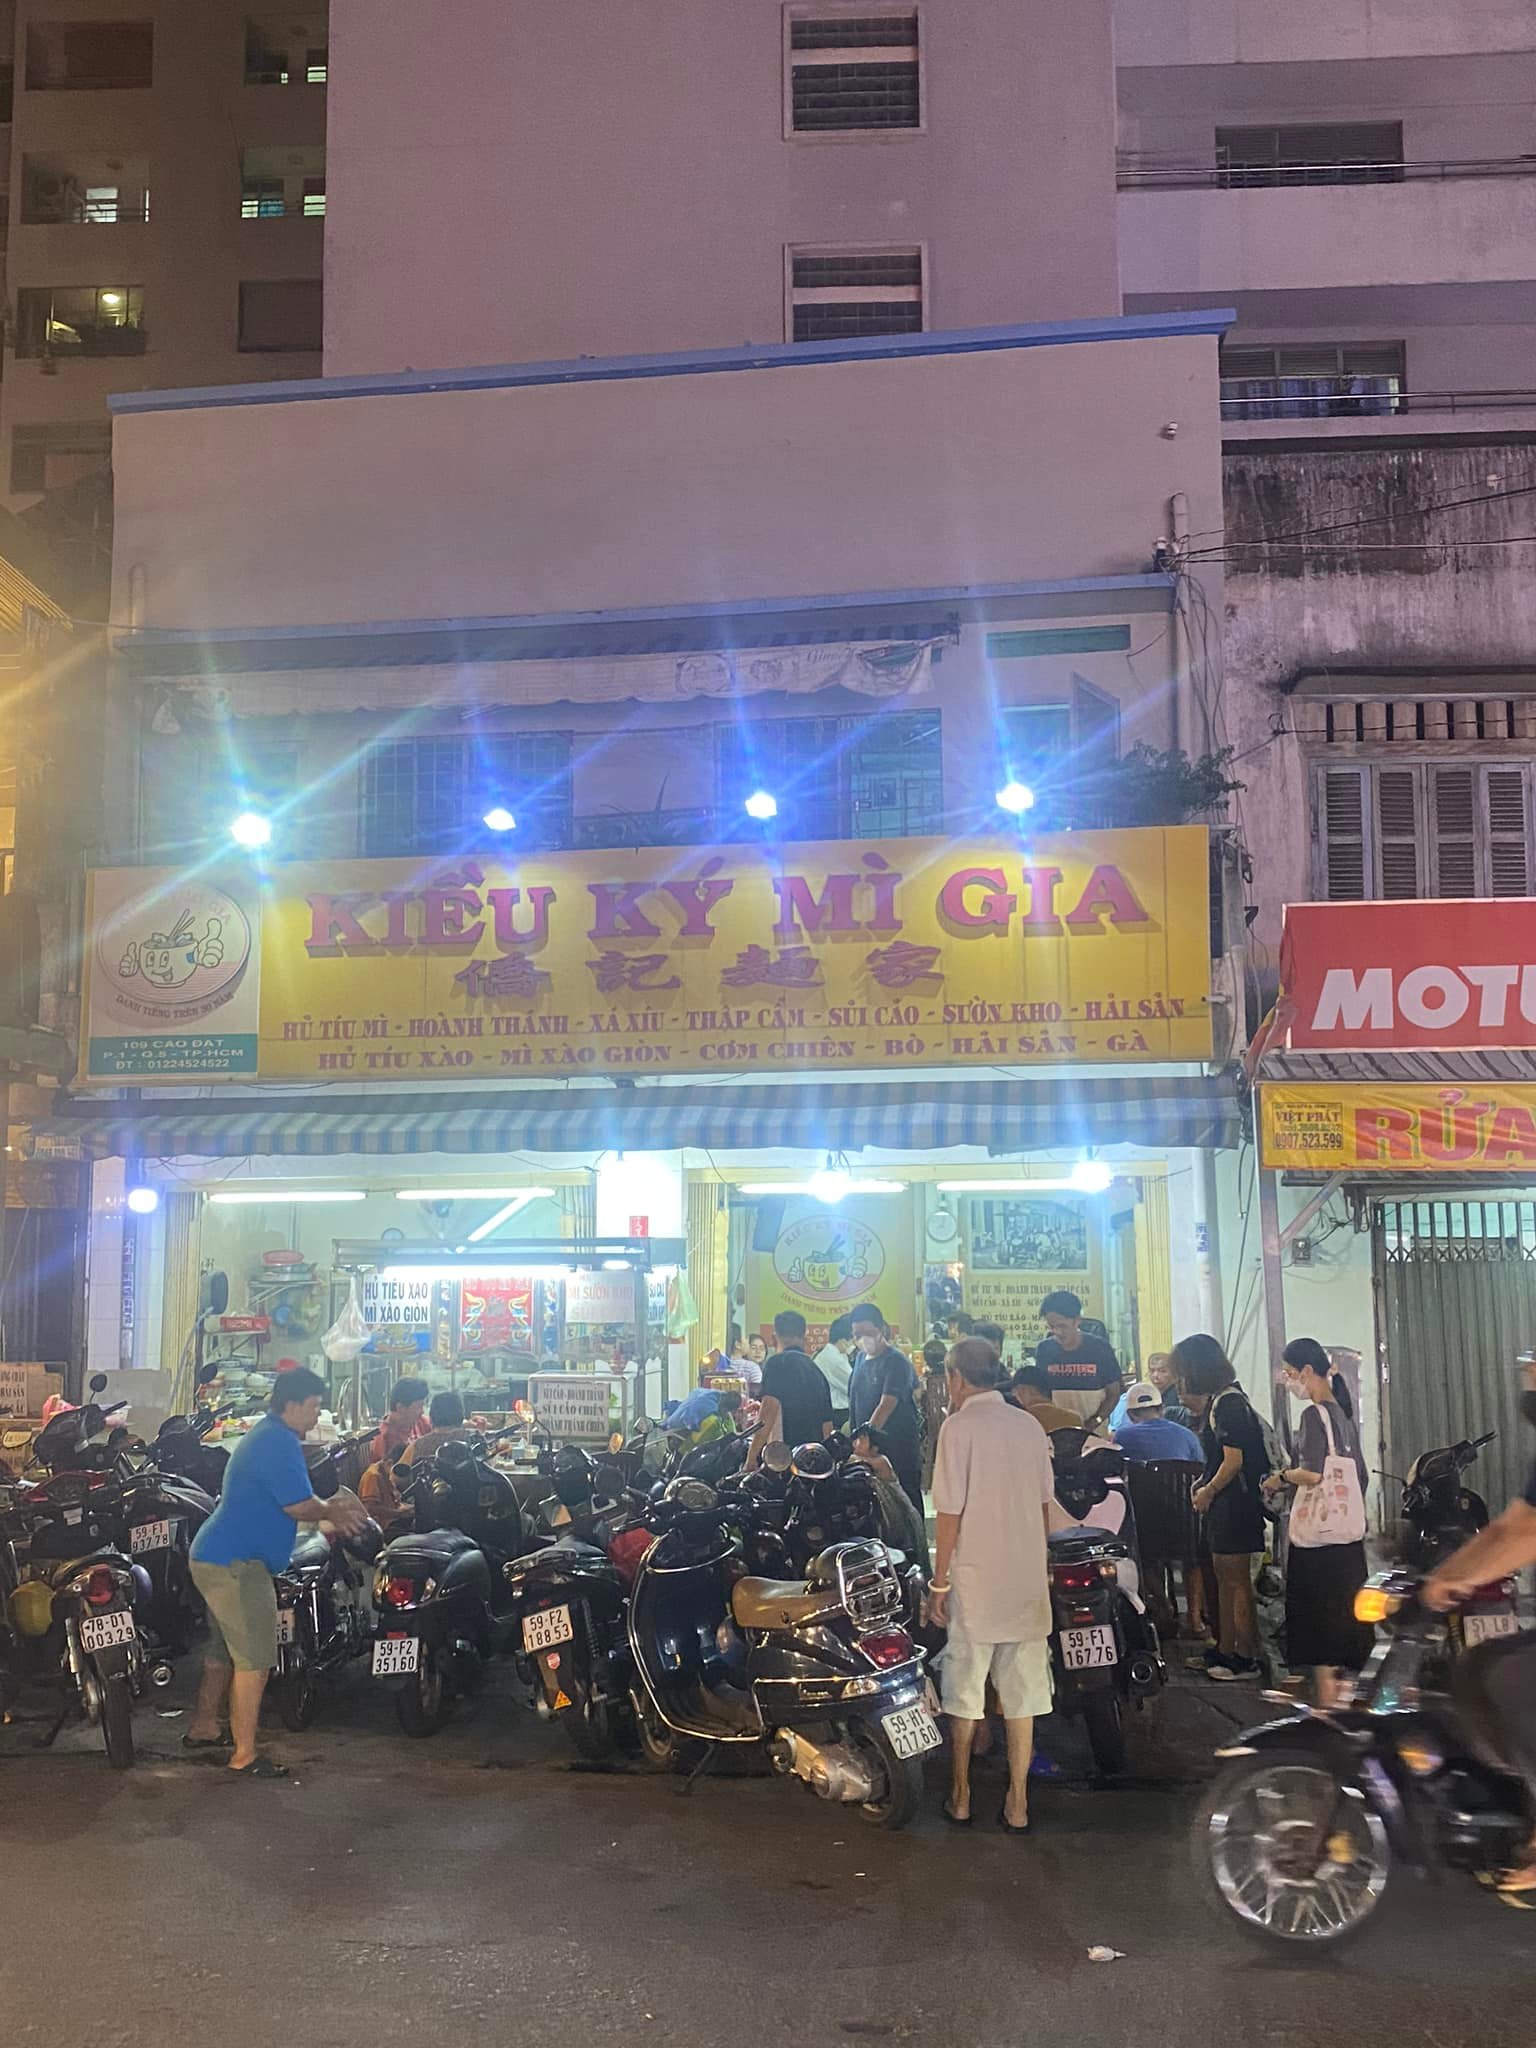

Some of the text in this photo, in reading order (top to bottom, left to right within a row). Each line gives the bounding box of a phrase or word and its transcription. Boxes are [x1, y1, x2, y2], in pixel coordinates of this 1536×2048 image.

[304, 852, 1150, 946] KIỀU KÝ MÌ GIA
[1311, 965, 1536, 1030] MOT
[283, 1014, 313, 1040] HỦ
[362, 1013, 389, 1038] MÌ
[408, 1011, 484, 1038] HOÀNH
[491, 1009, 569, 1035] THÁNH
[686, 1004, 750, 1031] THẬP
[828, 999, 869, 1027] SỦI
[1011, 1001, 1062, 1023] KHO
[1085, 992, 1130, 1020] HẢI
[1137, 992, 1185, 1019] SẢN
[152, 1039, 188, 1048] CAO
[318, 1045, 357, 1070] HỦ
[365, 1045, 412, 1069] TÍU
[417, 1045, 474, 1068] XÀO
[501, 1042, 533, 1065] MÌ
[540, 1042, 597, 1065] XÀO
[603, 1039, 672, 1063] GIÒN
[700, 1040, 759, 1060] CƠM
[767, 1035, 856, 1059] CHIÊN
[884, 1033, 925, 1056] BÒ
[952, 1030, 1009, 1054] HẢI
[1018, 1030, 1077, 1054] SẢN
[1106, 1029, 1150, 1052] GÀ
[1276, 1109, 1304, 1124] VIỆT
[1355, 1088, 1536, 1161] RỬA
[365, 1275, 378, 1300] HỦ
[365, 1302, 428, 1322] MÌ XÀO GIÒN
[380, 1640, 413, 1657] 59-F2
[889, 1707, 926, 1734] 59-H1
